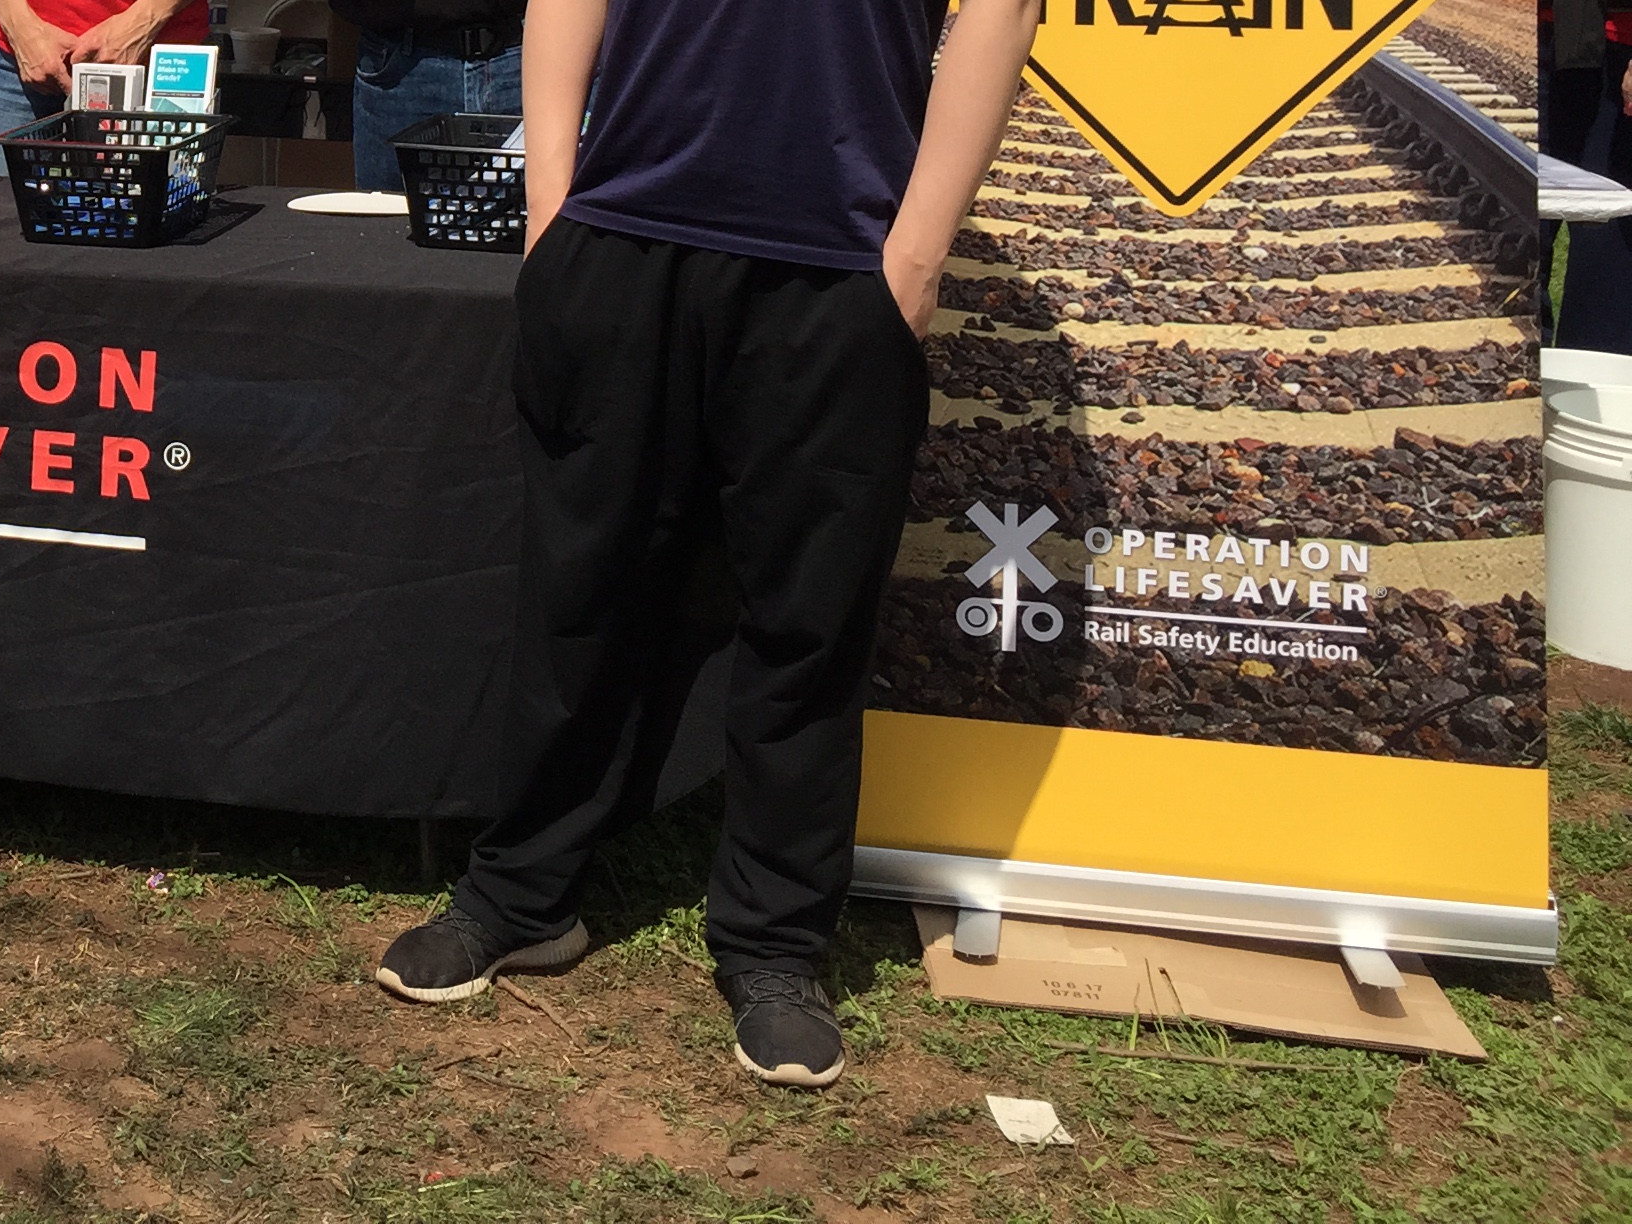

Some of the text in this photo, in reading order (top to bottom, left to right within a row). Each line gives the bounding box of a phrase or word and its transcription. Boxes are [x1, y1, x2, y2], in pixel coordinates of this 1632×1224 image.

[1084, 526, 1368, 573] OPERATION
[1084, 620, 1358, 662] Rail Safety Education
